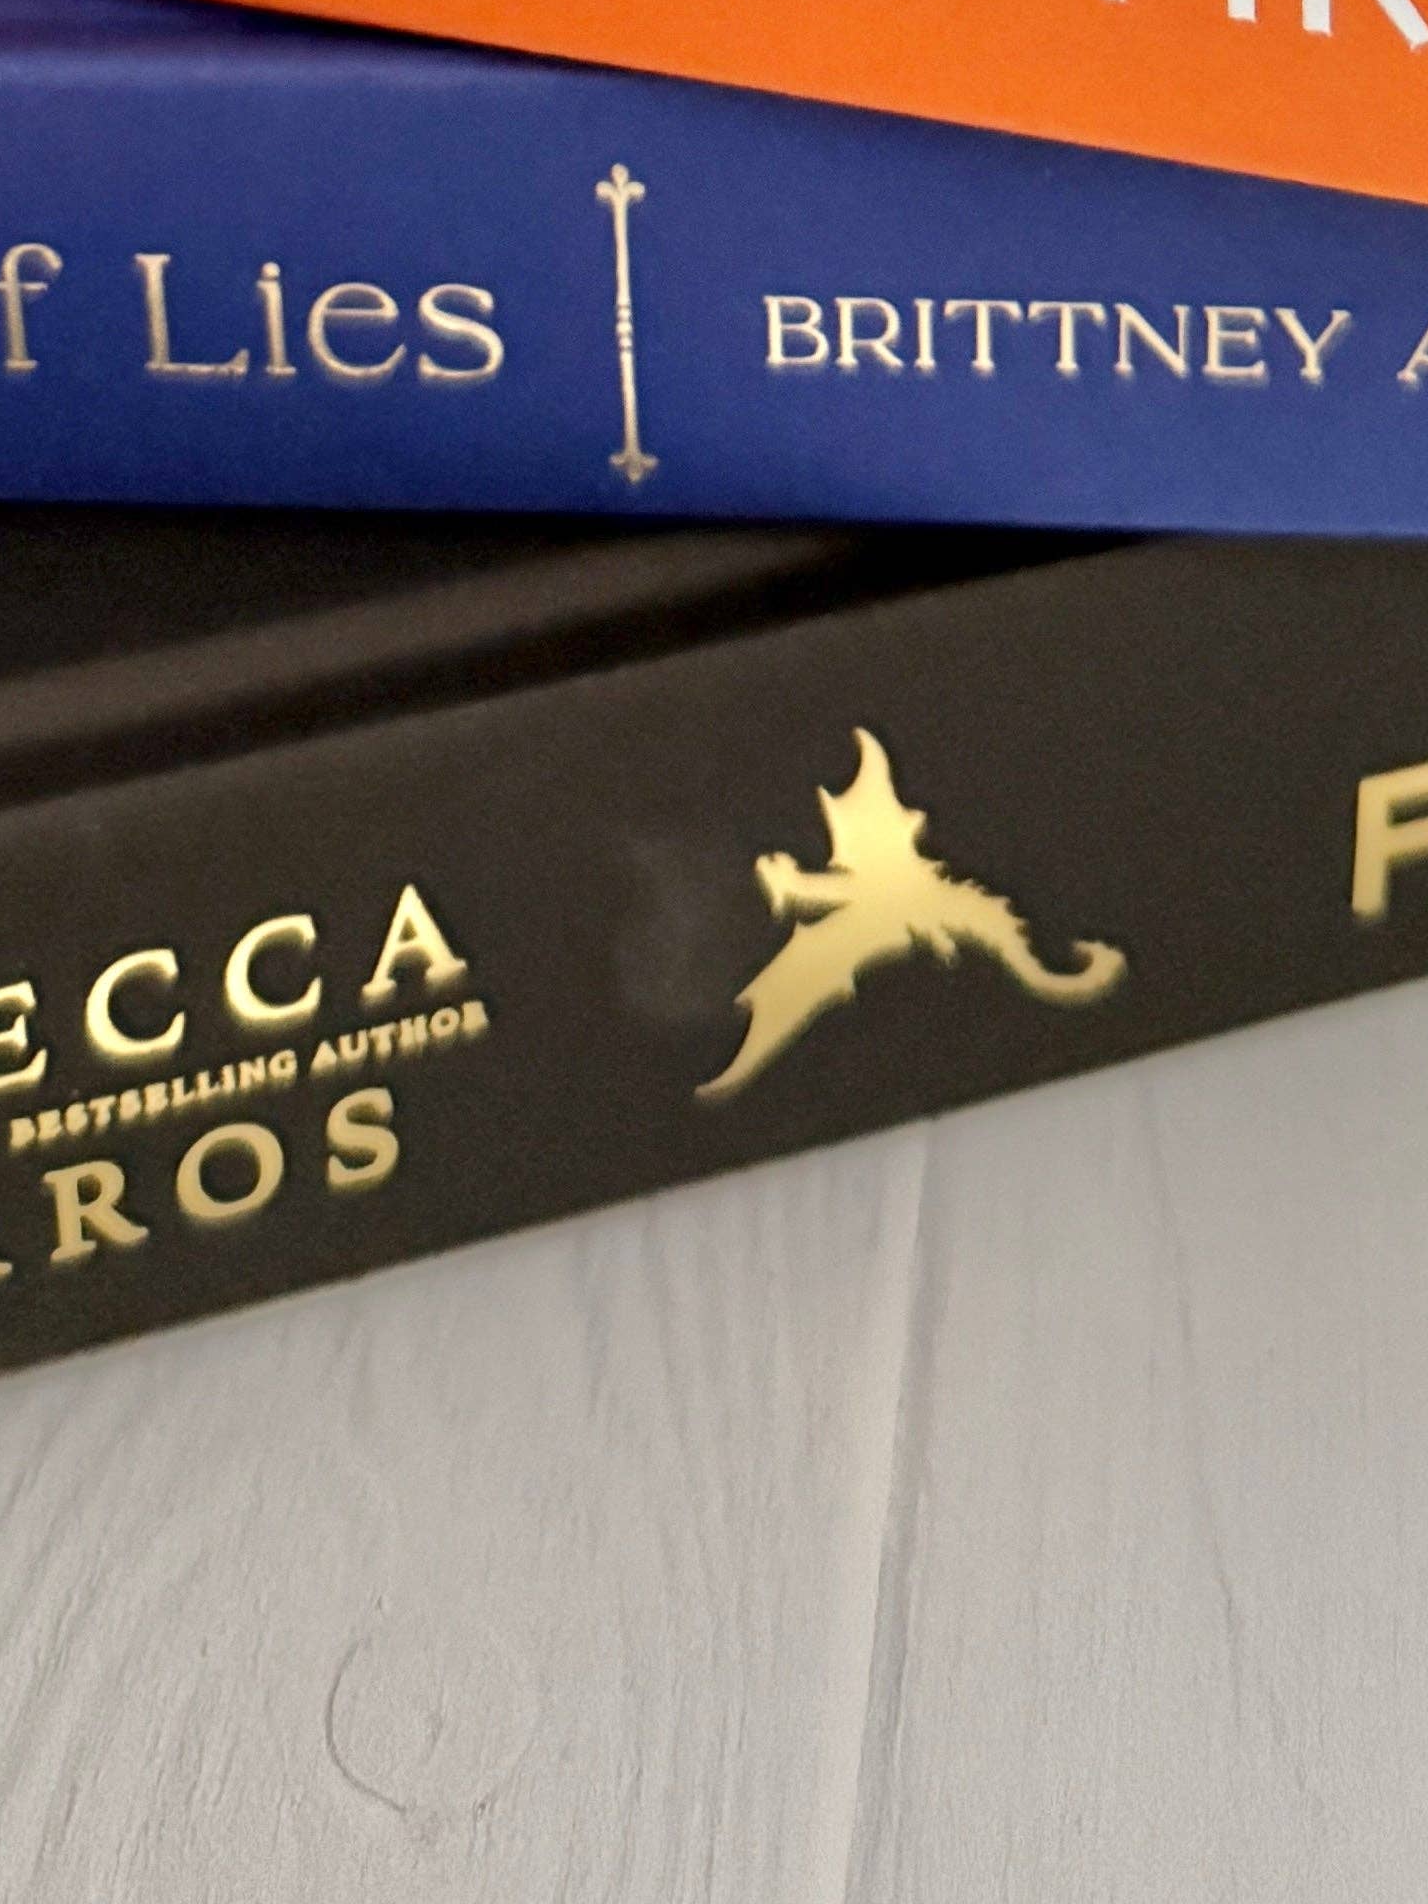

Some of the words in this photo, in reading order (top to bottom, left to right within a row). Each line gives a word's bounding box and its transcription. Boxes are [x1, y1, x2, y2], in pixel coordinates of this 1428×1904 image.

[135, 252, 506, 382] Lies
[763, 294, 1352, 385] BRITTNEY
[9, 1049, 299, 1152] BESTSELLING
[310, 1000, 489, 1076] AUTHOR
